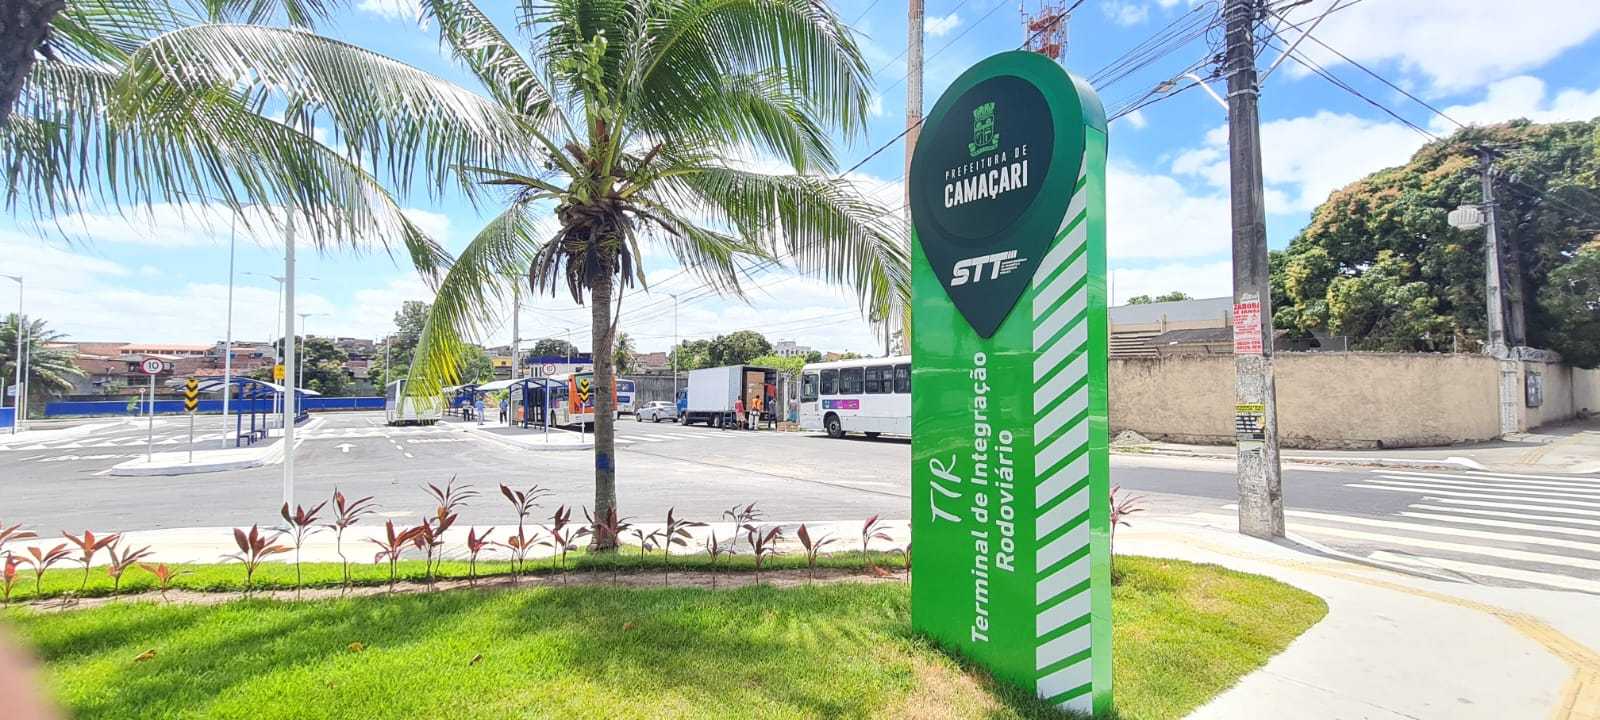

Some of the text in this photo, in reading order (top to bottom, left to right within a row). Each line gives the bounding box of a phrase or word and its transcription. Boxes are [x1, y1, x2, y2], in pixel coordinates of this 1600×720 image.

[944, 160, 1028, 208] CAMAÇARI
[945, 151, 1007, 181] PREFEITURA
[1014, 144, 1028, 158] DE
[951, 250, 1014, 287] STT
[148, 361, 160, 370] 10
[930, 454, 963, 524] TIR
[970, 351, 992, 643] Terminal de Integração
[996, 430, 1015, 571] Rodoviário
